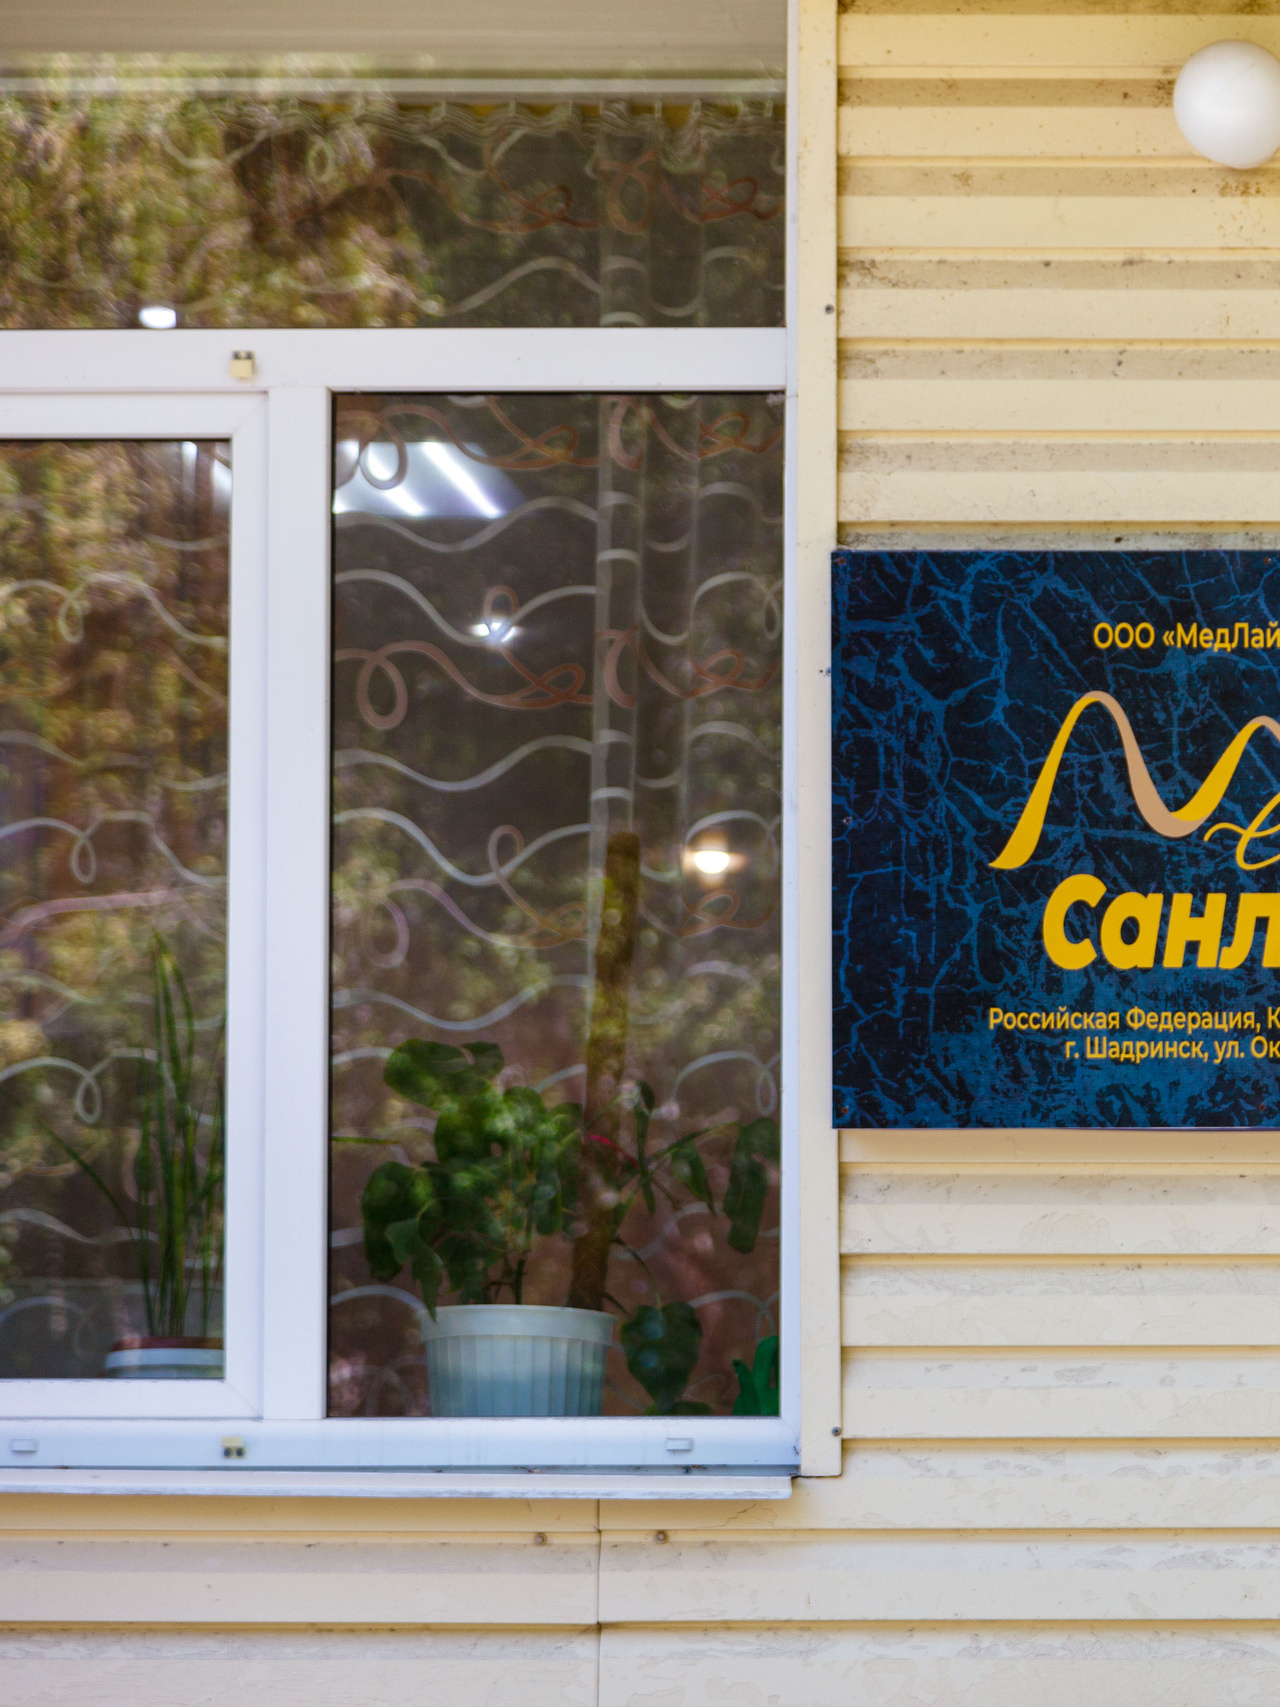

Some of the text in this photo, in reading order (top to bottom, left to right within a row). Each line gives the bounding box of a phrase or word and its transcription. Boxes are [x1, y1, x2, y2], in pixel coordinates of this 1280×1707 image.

[1093, 622, 1155, 649] ООО
[989, 1005, 1120, 1031] Российская
[1126, 1005, 1261, 1034] Федерация,
[1065, 1040, 1080, 1059] г.
[1086, 1036, 1209, 1064] Шадринск,
[1213, 1040, 1245, 1064] ул.
